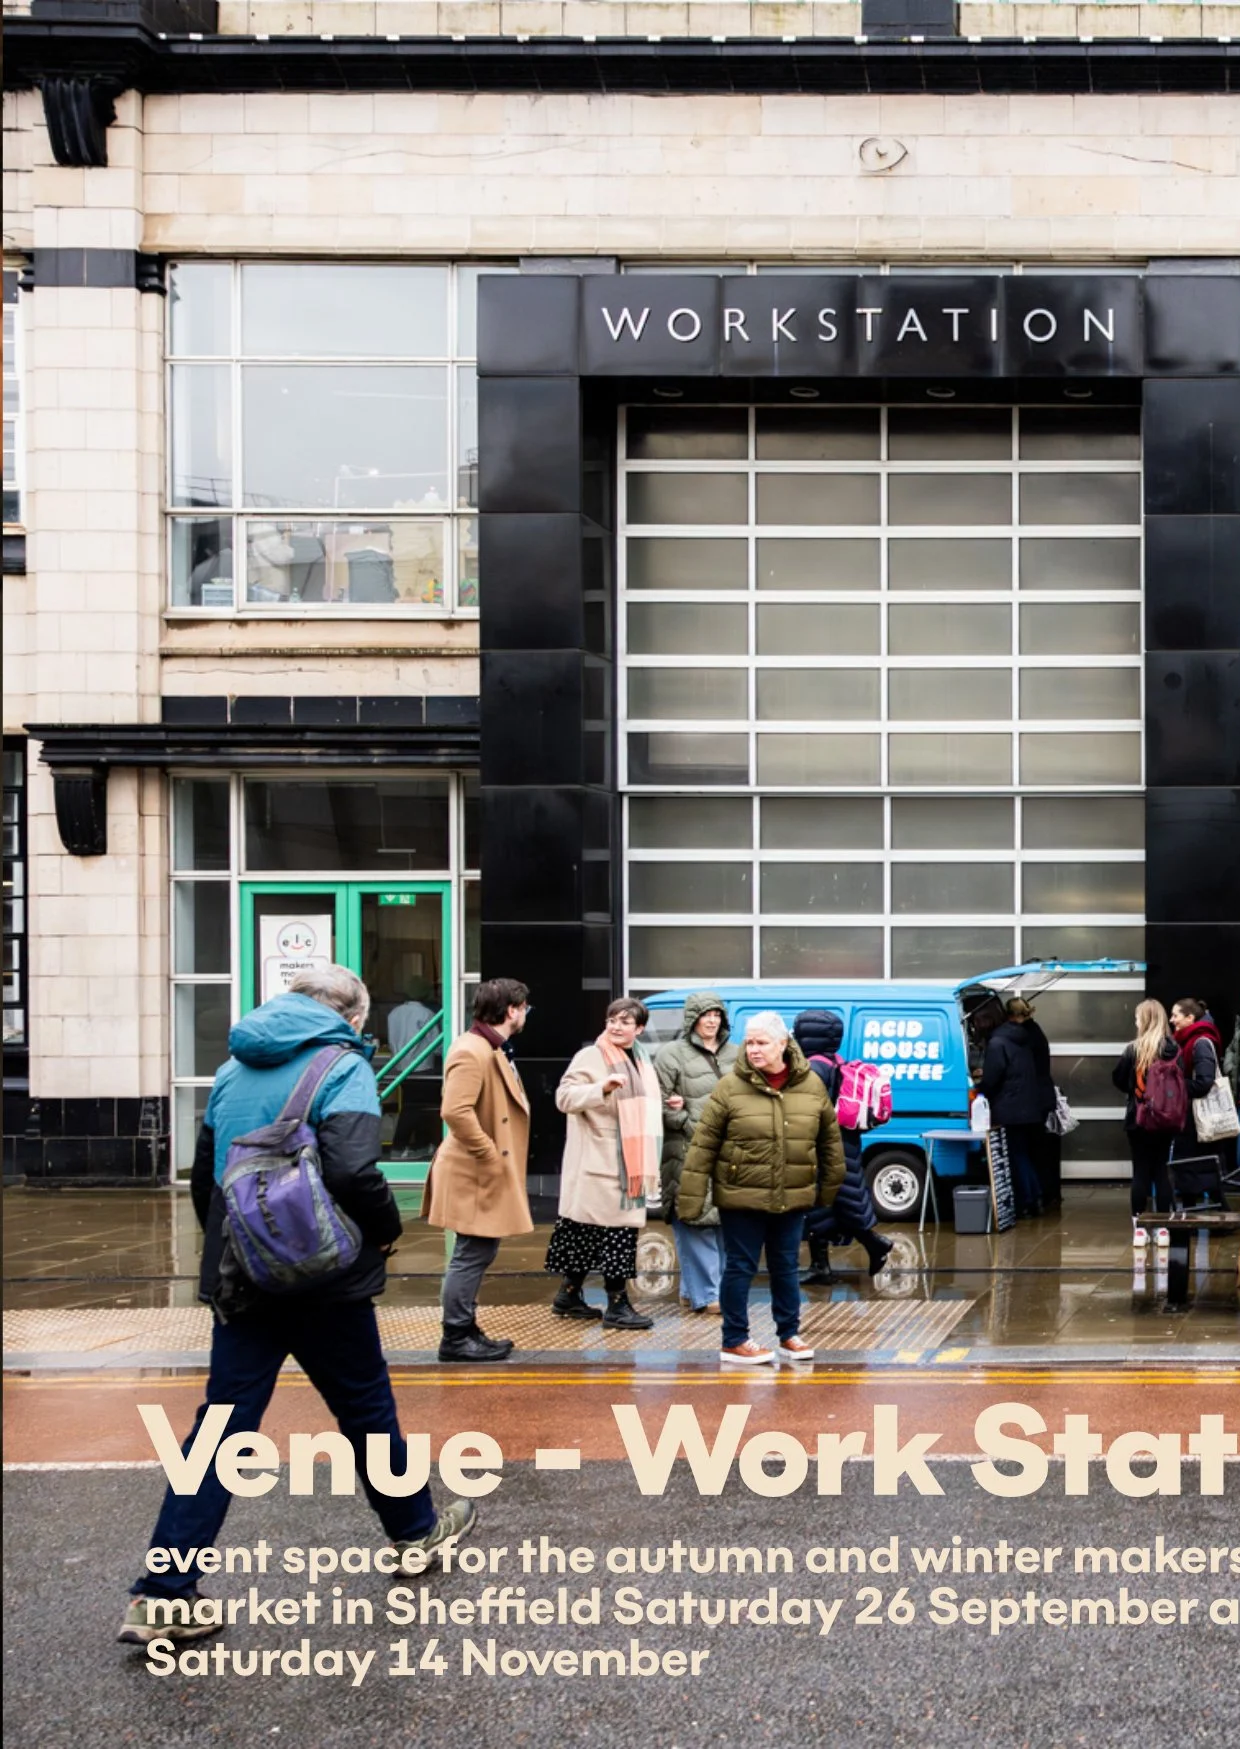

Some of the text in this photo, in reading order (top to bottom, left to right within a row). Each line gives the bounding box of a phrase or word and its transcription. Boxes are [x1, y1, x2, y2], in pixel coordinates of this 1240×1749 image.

[602, 307, 1116, 342] WORKSTATION
[280, 962, 314, 970] makers
[864, 1020, 923, 1038] ACID
[862, 1040, 941, 1060] HOUSE
[878, 1063, 944, 1081] OFFEE
